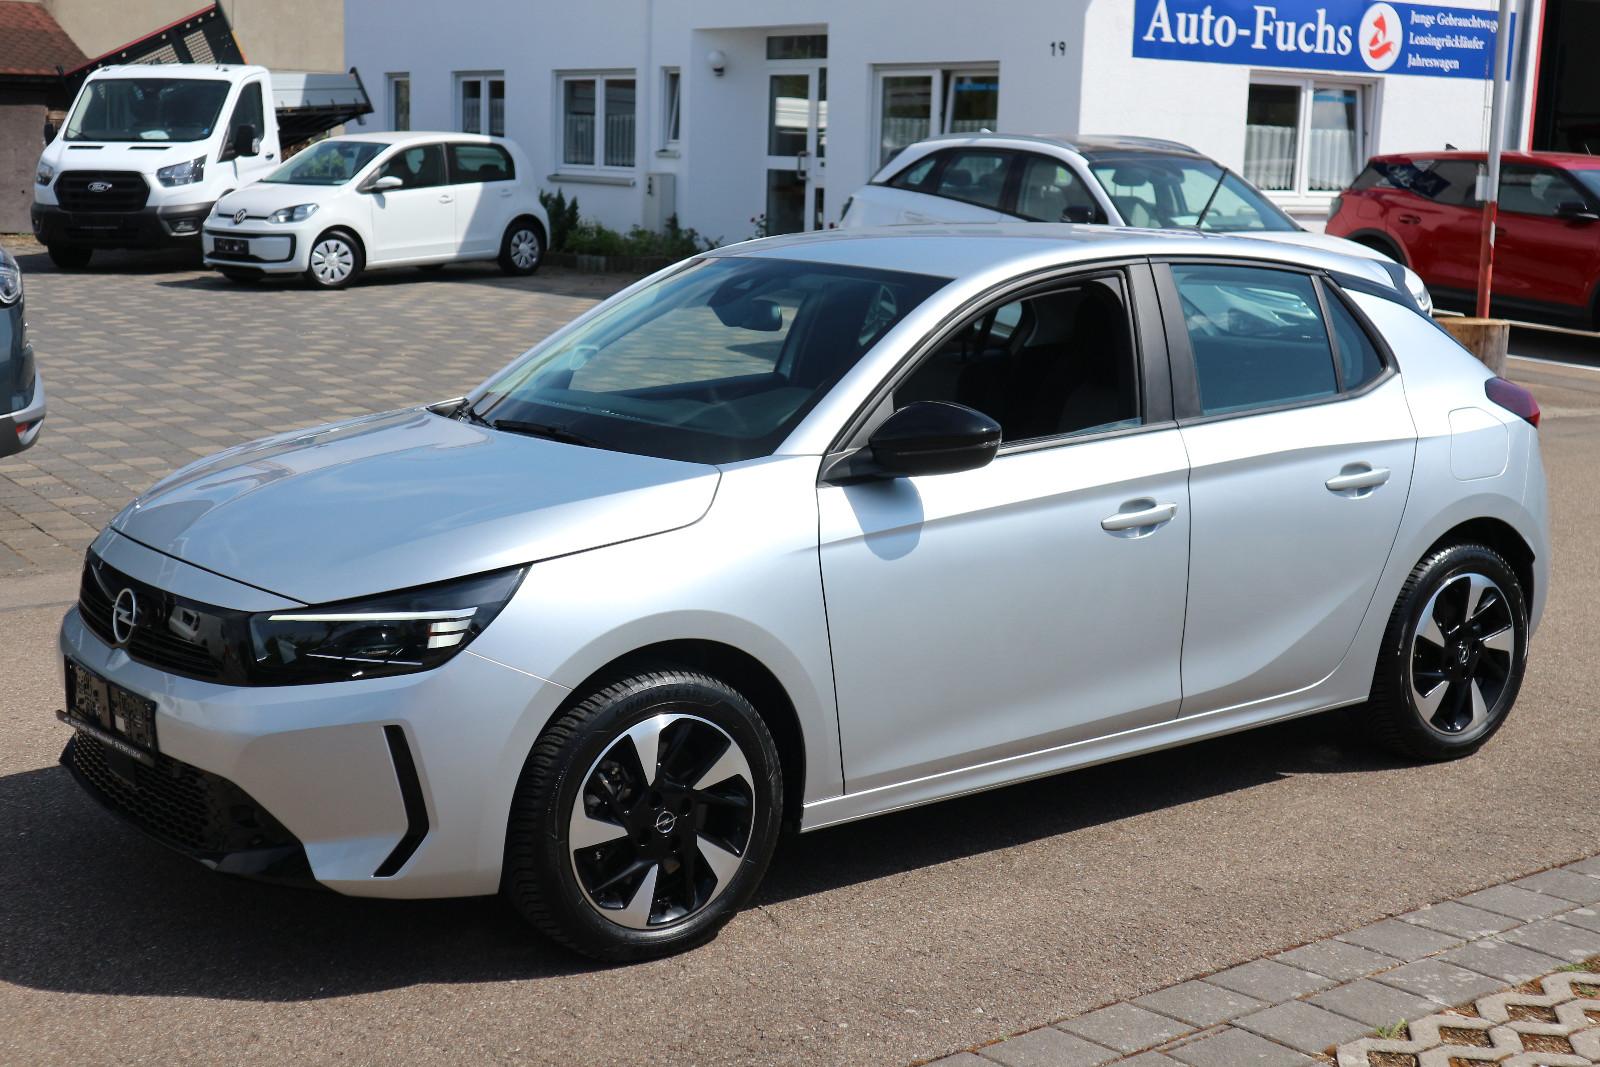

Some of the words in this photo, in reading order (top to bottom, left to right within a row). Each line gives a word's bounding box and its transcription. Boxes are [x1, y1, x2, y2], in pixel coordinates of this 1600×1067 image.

[1142, 0, 1353, 55] Auto-Fuchs
[1410, 10, 1435, 28] Junge
[1050, 41, 1066, 57] 19
[1407, 53, 1459, 72] Jahreswagen
